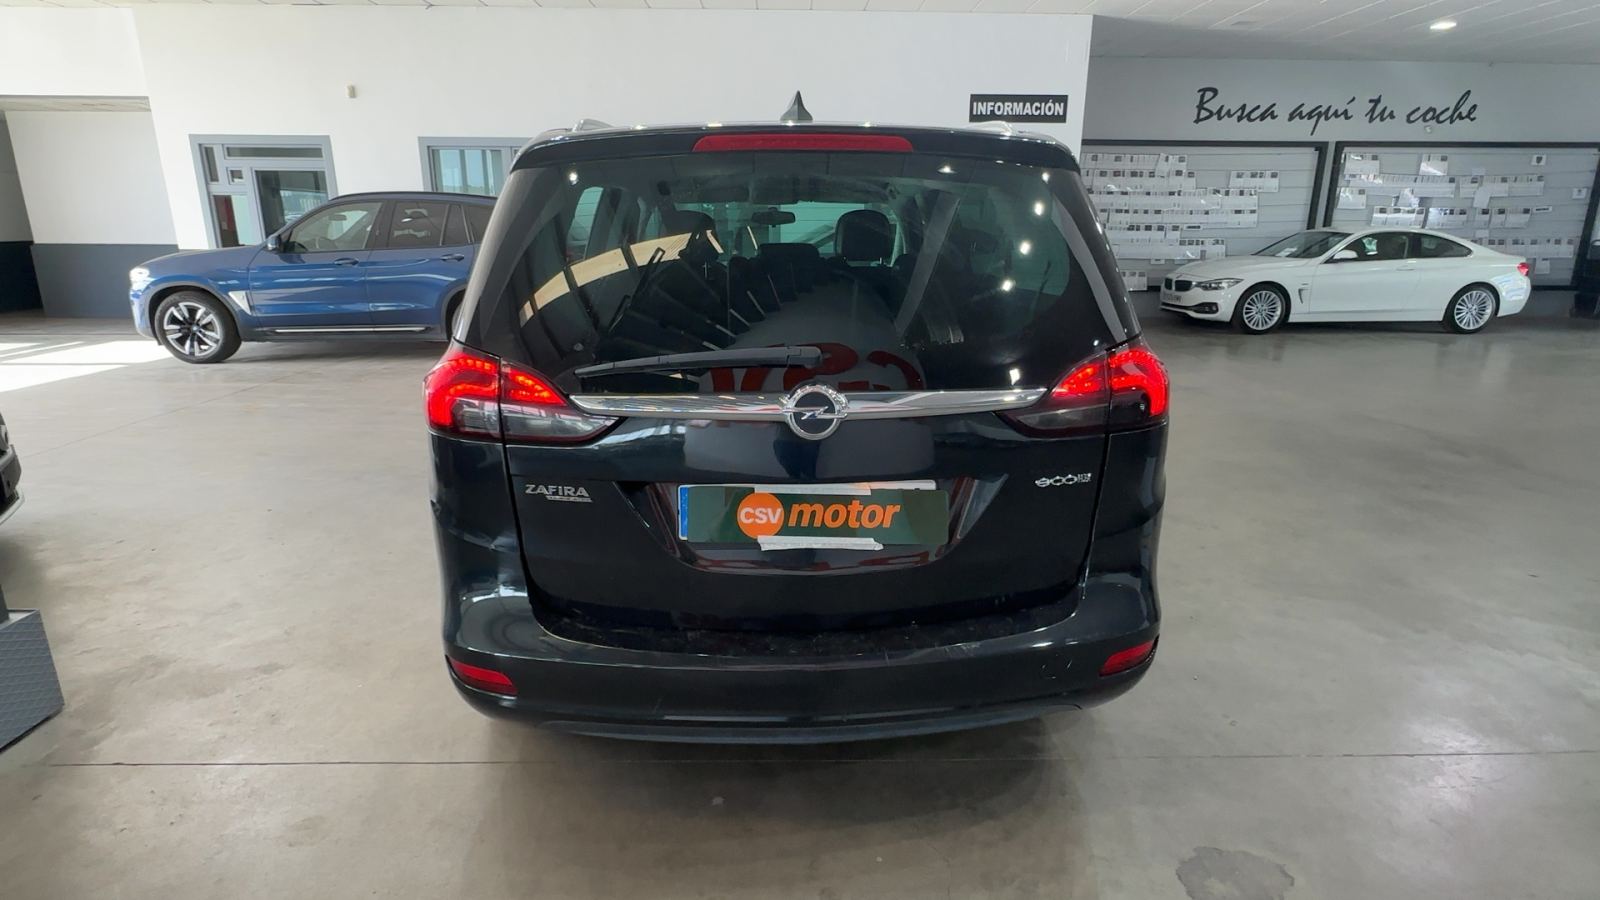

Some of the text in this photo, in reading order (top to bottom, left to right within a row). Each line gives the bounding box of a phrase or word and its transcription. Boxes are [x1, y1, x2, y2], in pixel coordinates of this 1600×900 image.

[972, 99, 1065, 117] INFORMACIÓN
[1193, 87, 1478, 136] Busca aquí tu coche
[525, 484, 590, 497] ZAFIRA
[738, 500, 901, 529] CSV motor
